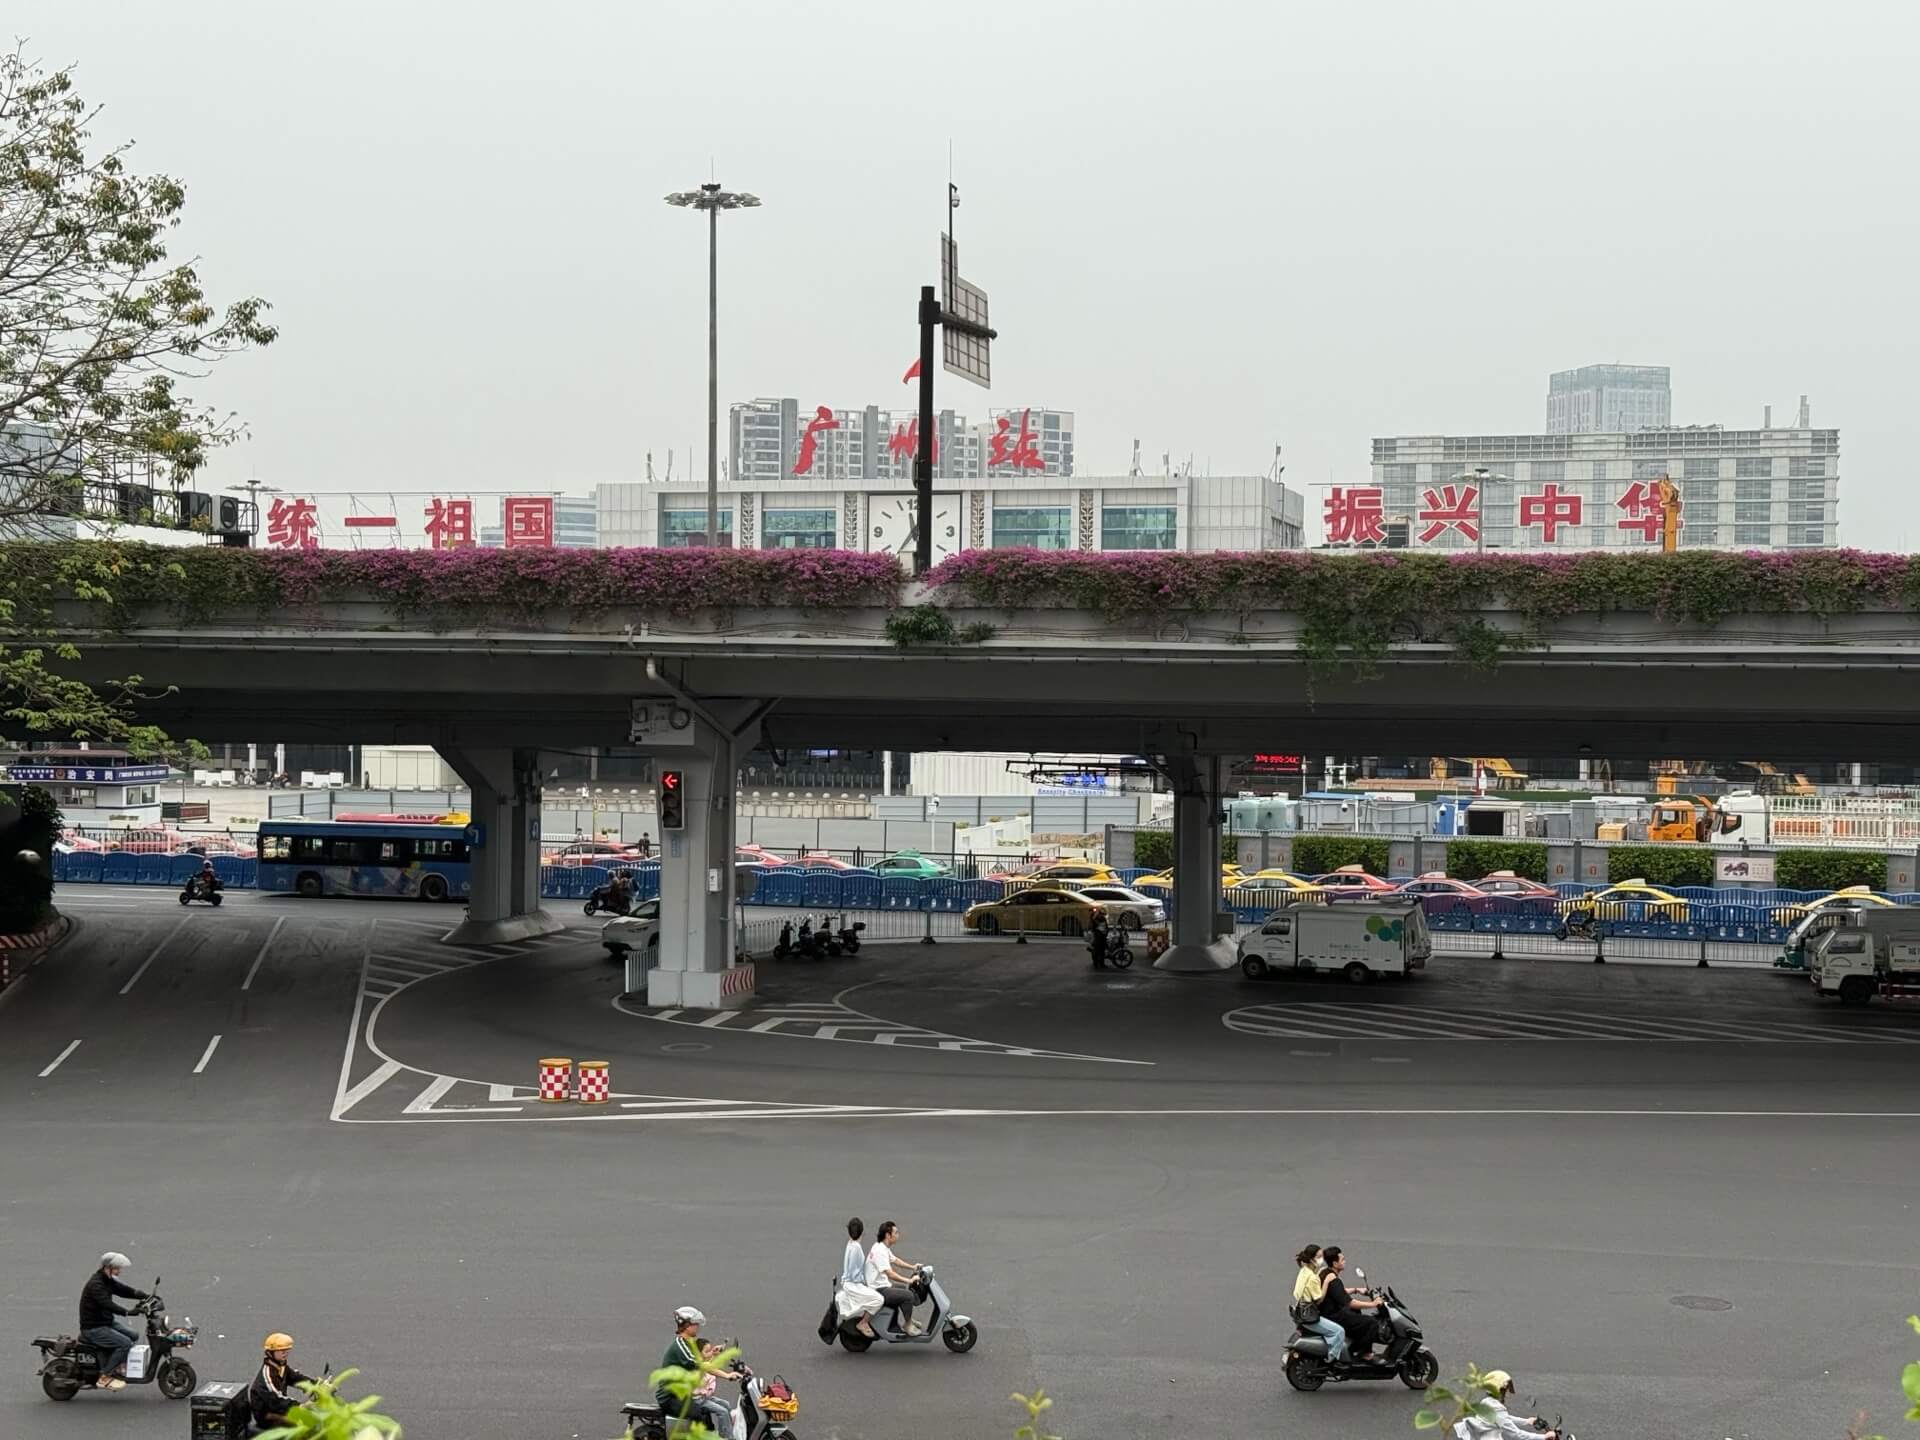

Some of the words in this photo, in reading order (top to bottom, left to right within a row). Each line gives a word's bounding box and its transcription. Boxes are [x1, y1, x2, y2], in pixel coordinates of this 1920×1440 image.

[791, 405, 1046, 475] 广州站
[266, 497, 553, 549] 统一祖国
[873, 525, 884, 539] 9
[945, 524, 956, 538] 3
[1323, 480, 1684, 544] 振兴中华
